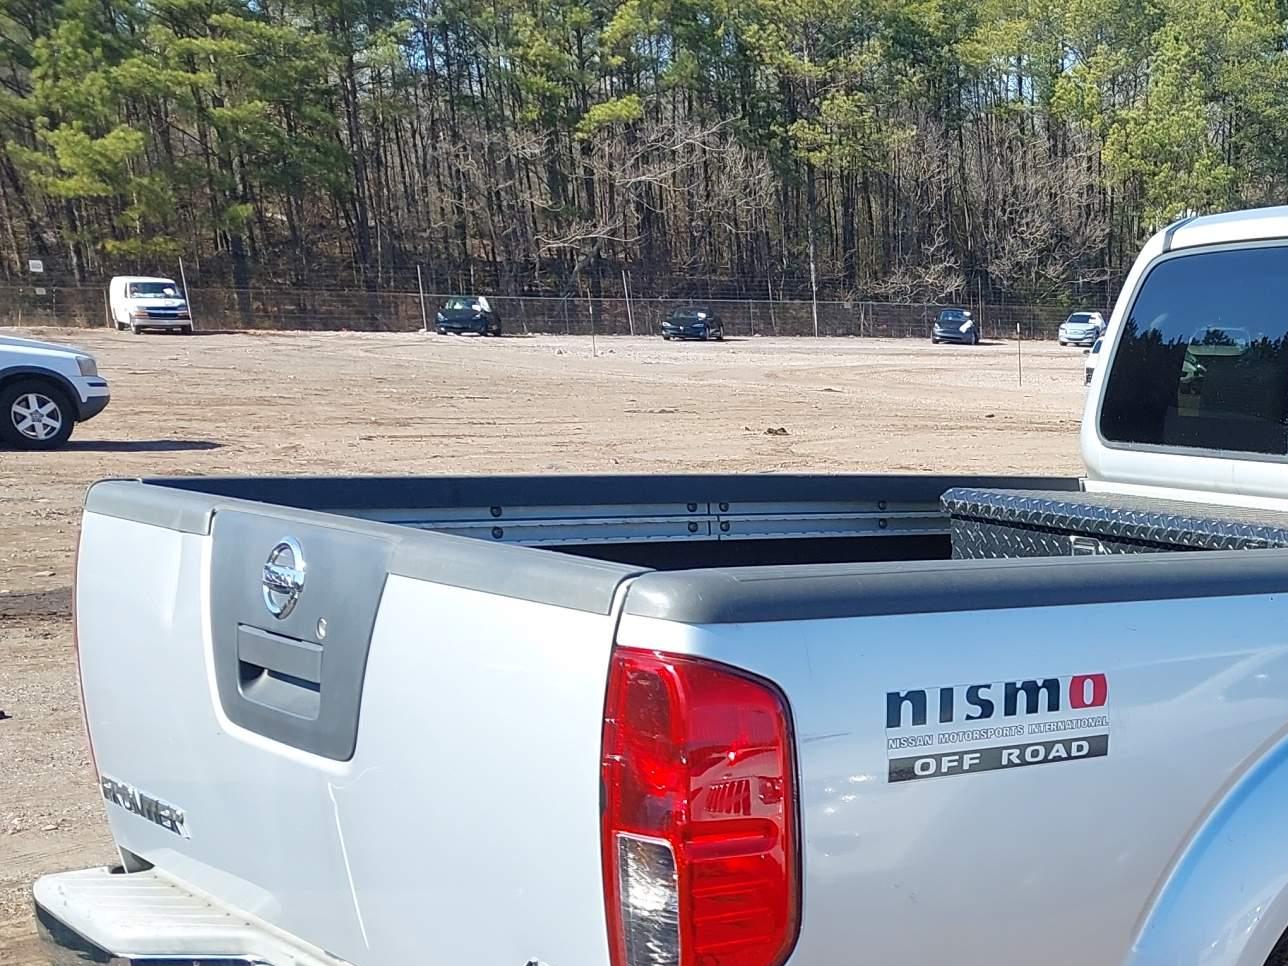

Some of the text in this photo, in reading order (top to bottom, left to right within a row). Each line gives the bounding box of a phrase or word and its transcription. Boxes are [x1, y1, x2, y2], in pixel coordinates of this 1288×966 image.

[888, 715, 1109, 750] NISSAN MOTORSPORTS INTERNATIONAL
[913, 739, 1090, 777] OFF ROAD
